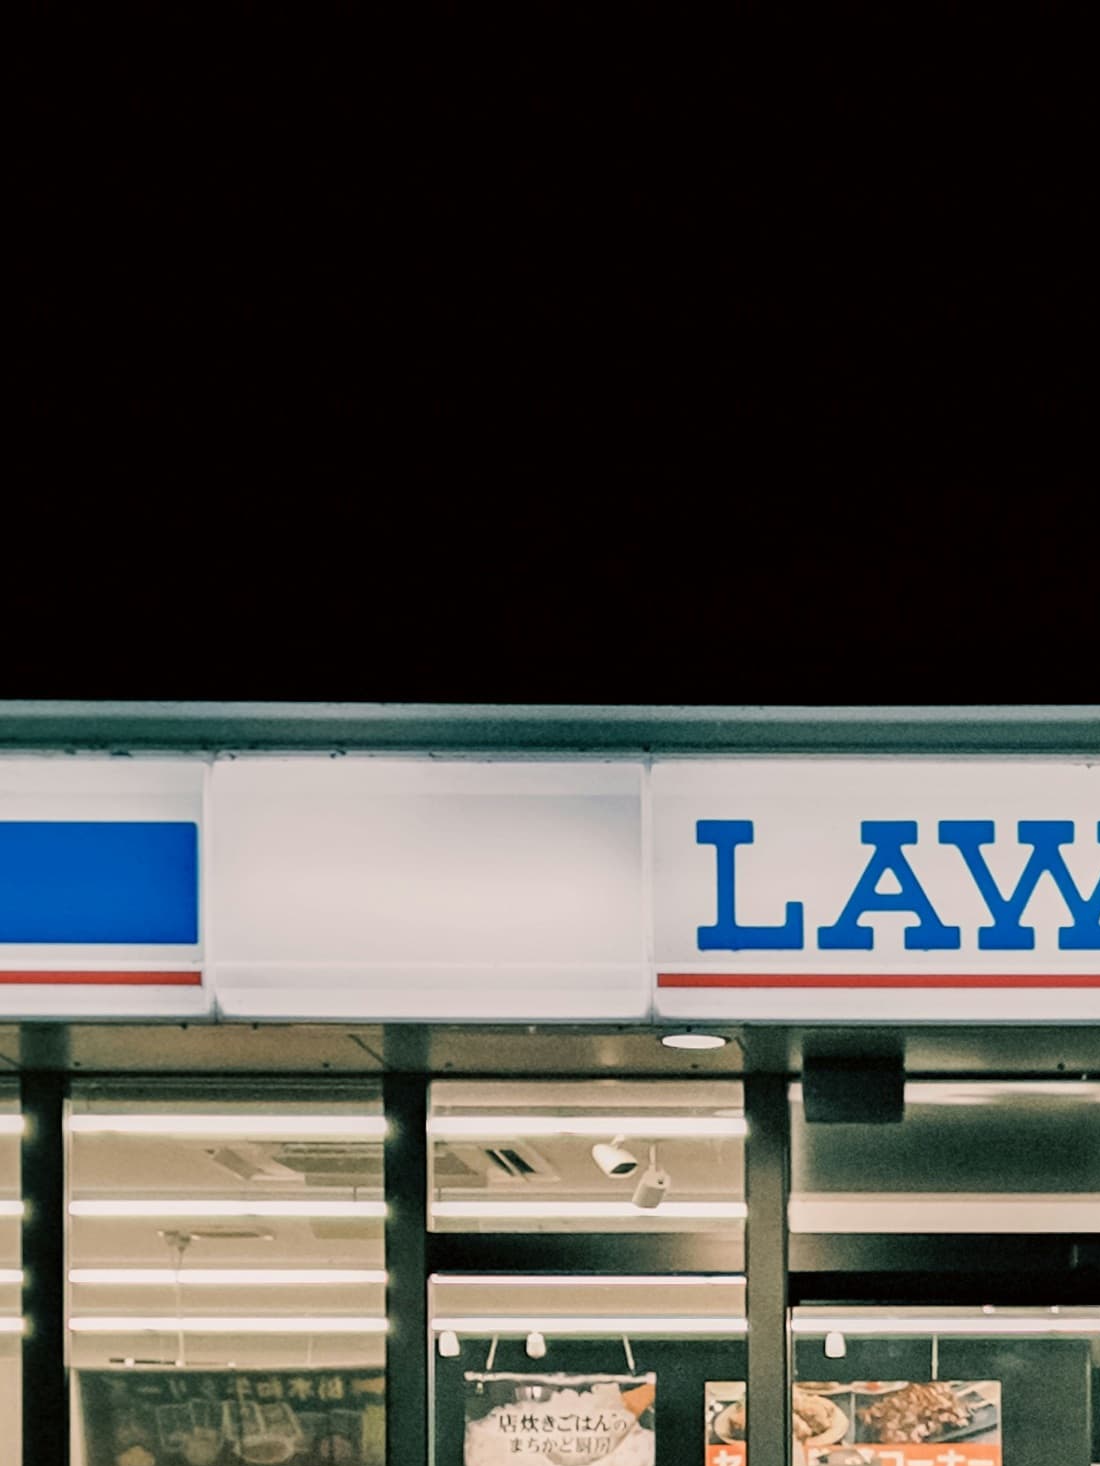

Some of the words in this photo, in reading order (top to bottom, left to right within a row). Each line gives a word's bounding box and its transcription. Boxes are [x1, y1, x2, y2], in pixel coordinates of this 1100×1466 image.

[510, 1437, 611, 1454] まちかど厨房
